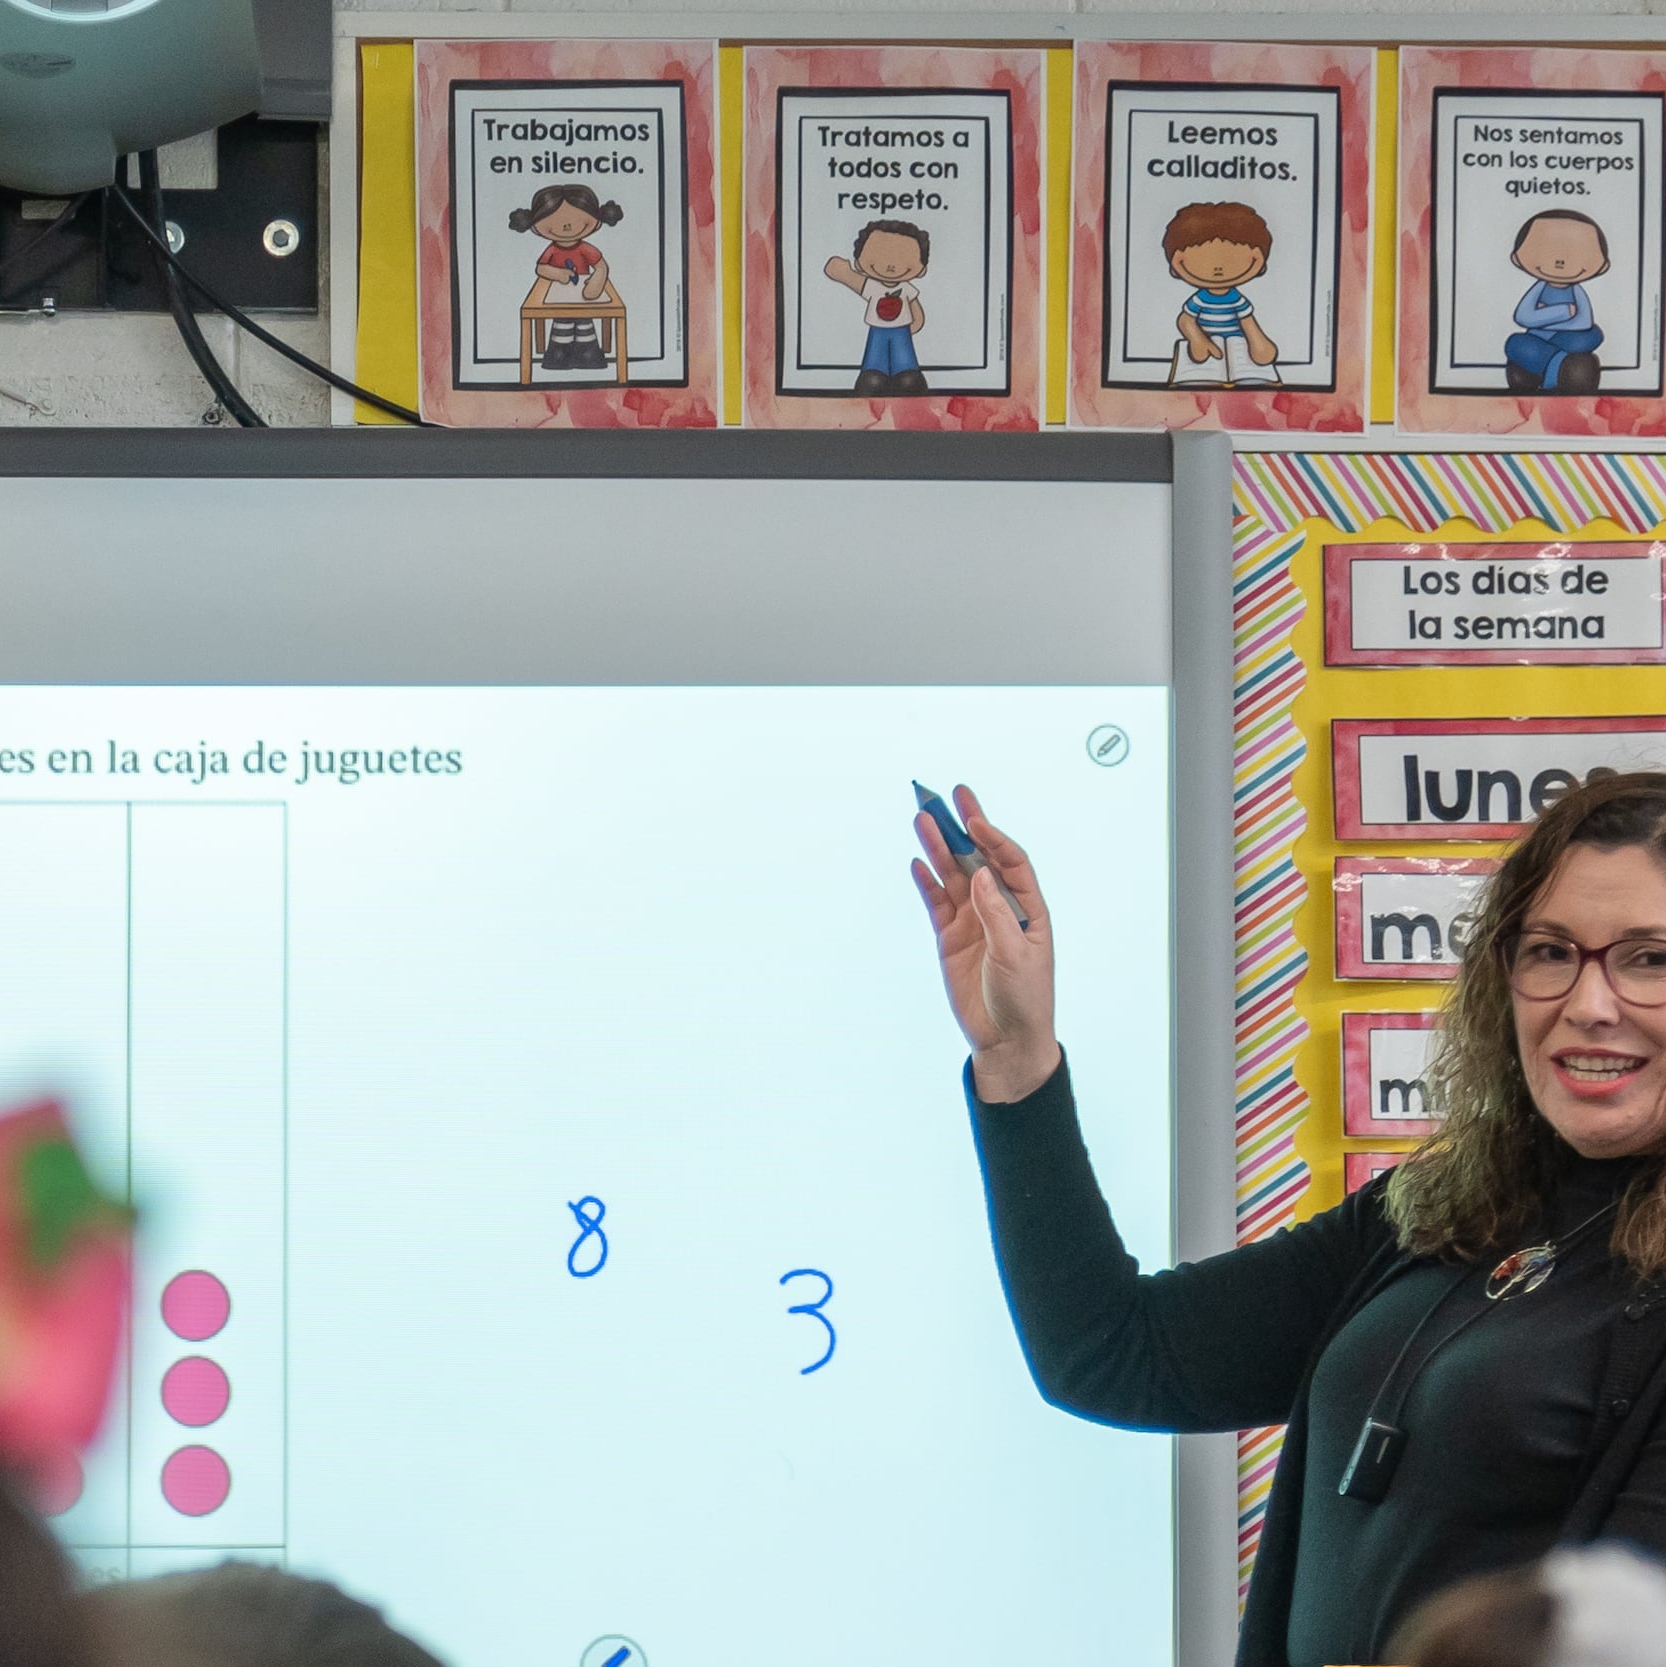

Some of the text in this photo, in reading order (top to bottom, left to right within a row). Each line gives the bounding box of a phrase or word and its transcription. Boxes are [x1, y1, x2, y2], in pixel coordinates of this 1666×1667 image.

[483, 119, 649, 146] Trabajamos
[818, 126, 969, 147] Tratamos a
[1168, 121, 1277, 146] Leemos
[1474, 125, 1623, 145] Nos sentamos
[490, 151, 643, 174] en silencio.
[828, 157, 958, 179] todos con
[1147, 155, 1297, 181] calladitos.
[1463, 151, 1634, 174] con los cuerpos
[1505, 177, 1590, 198] quietos.
[838, 189, 948, 214] respeto.
[1404, 564, 1609, 595] Los días de
[1409, 610, 1604, 640] la semana
[48, 750, 92, 773] en
[109, 740, 140, 773] la
[154, 740, 229, 785] caja
[243, 740, 287, 774] de
[297, 743, 463, 785] juguetes
[567, 1196, 608, 1278] 8
[780, 1269, 836, 1375] 3
